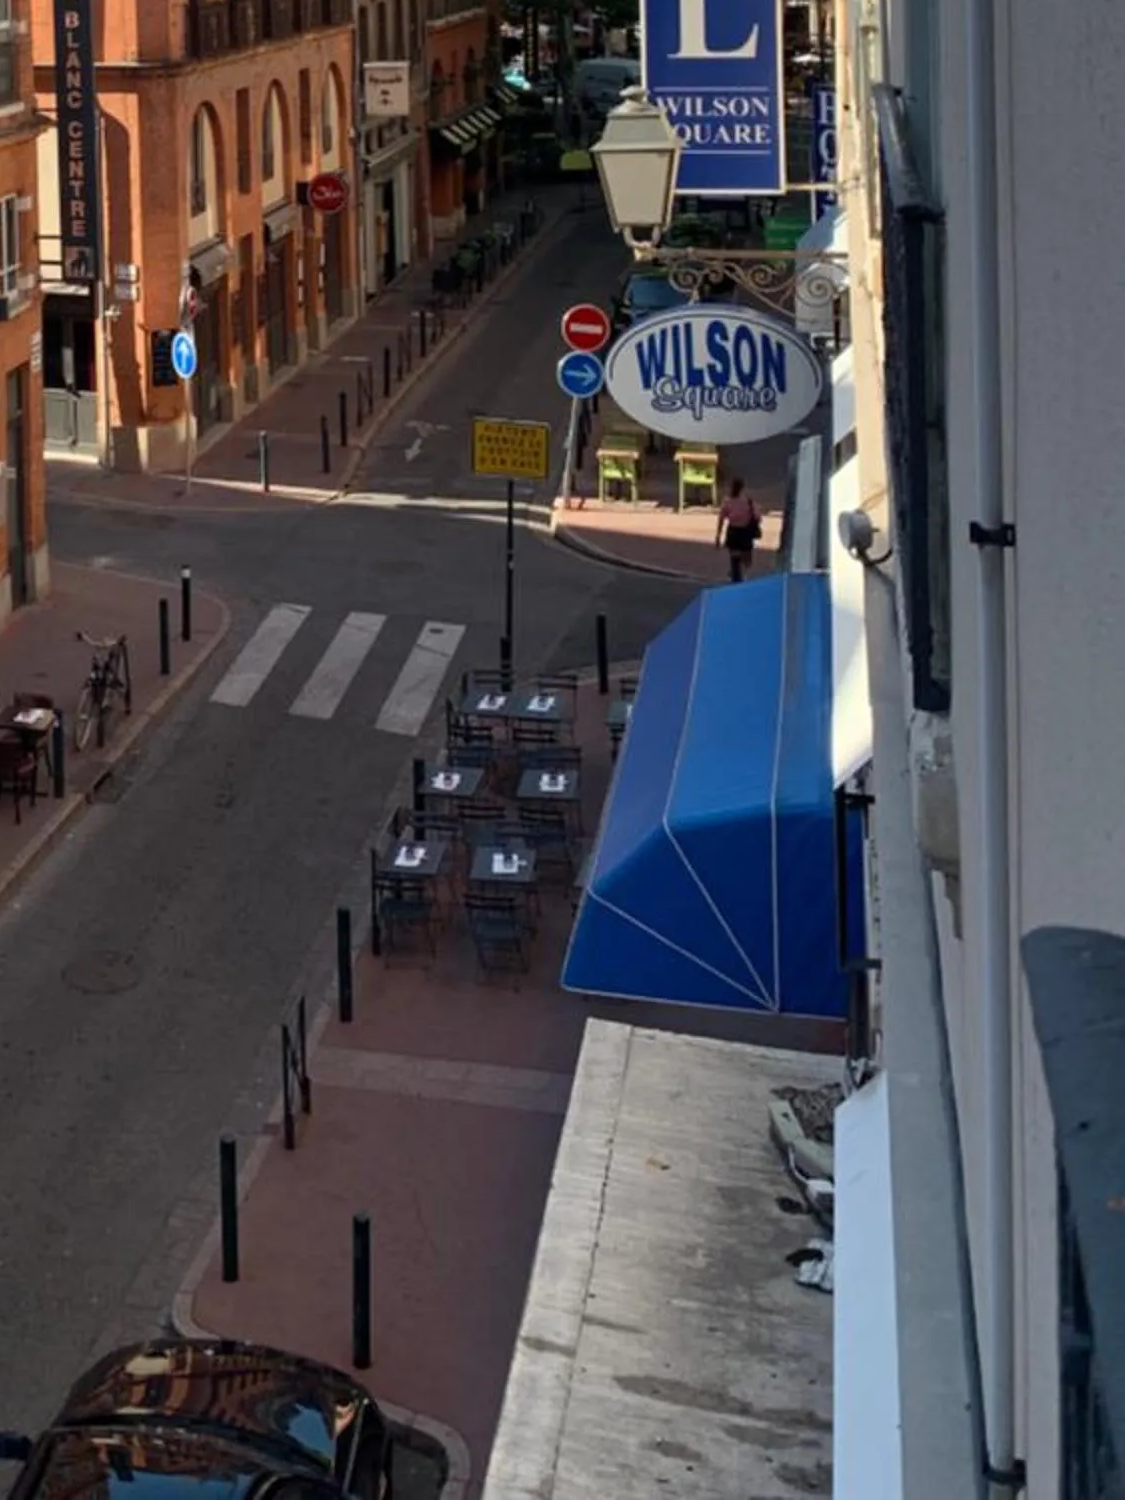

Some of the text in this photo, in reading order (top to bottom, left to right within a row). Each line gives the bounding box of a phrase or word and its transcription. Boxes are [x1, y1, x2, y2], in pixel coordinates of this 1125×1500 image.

[64, 10, 82, 109] BLANC
[655, 96, 772, 117] WILSON
[672, 123, 773, 148] QUARE
[67, 120, 86, 237] CENTRE
[634, 320, 786, 393] WILSON
[651, 374, 777, 421] Square
